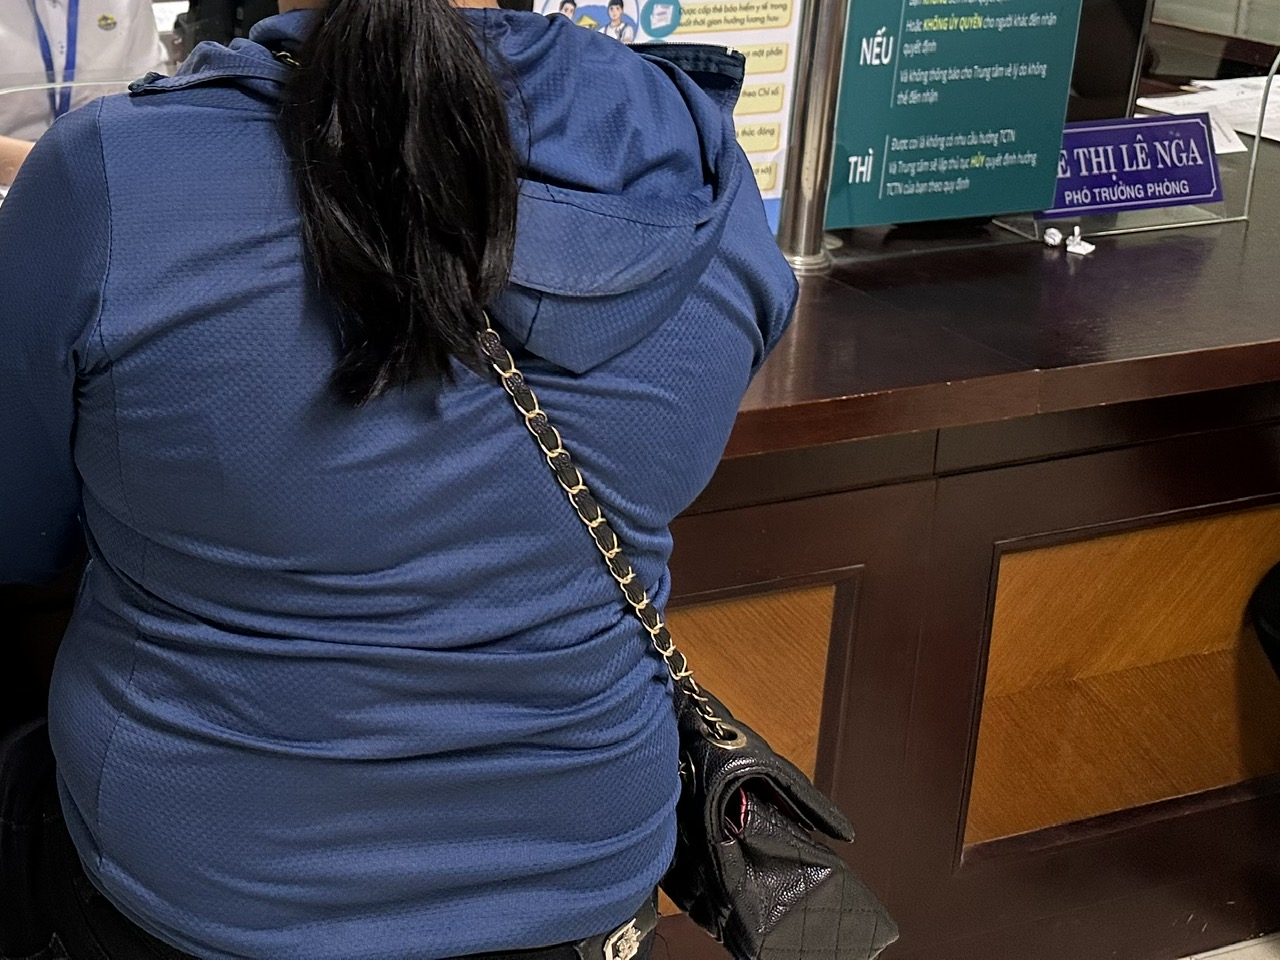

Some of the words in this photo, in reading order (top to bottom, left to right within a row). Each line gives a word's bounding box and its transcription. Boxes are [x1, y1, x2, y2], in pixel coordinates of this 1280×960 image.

[859, 28, 893, 66] NẾU
[848, 150, 873, 184] THÌ
[1074, 145, 1117, 181] THỊ
[1120, 134, 1151, 171] LÊ
[1155, 138, 1203, 168] NGA
[1065, 186, 1091, 205] PHÓ
[1094, 180, 1142, 202] TRƯỞNG
[1148, 178, 1189, 196] PHÒNG
